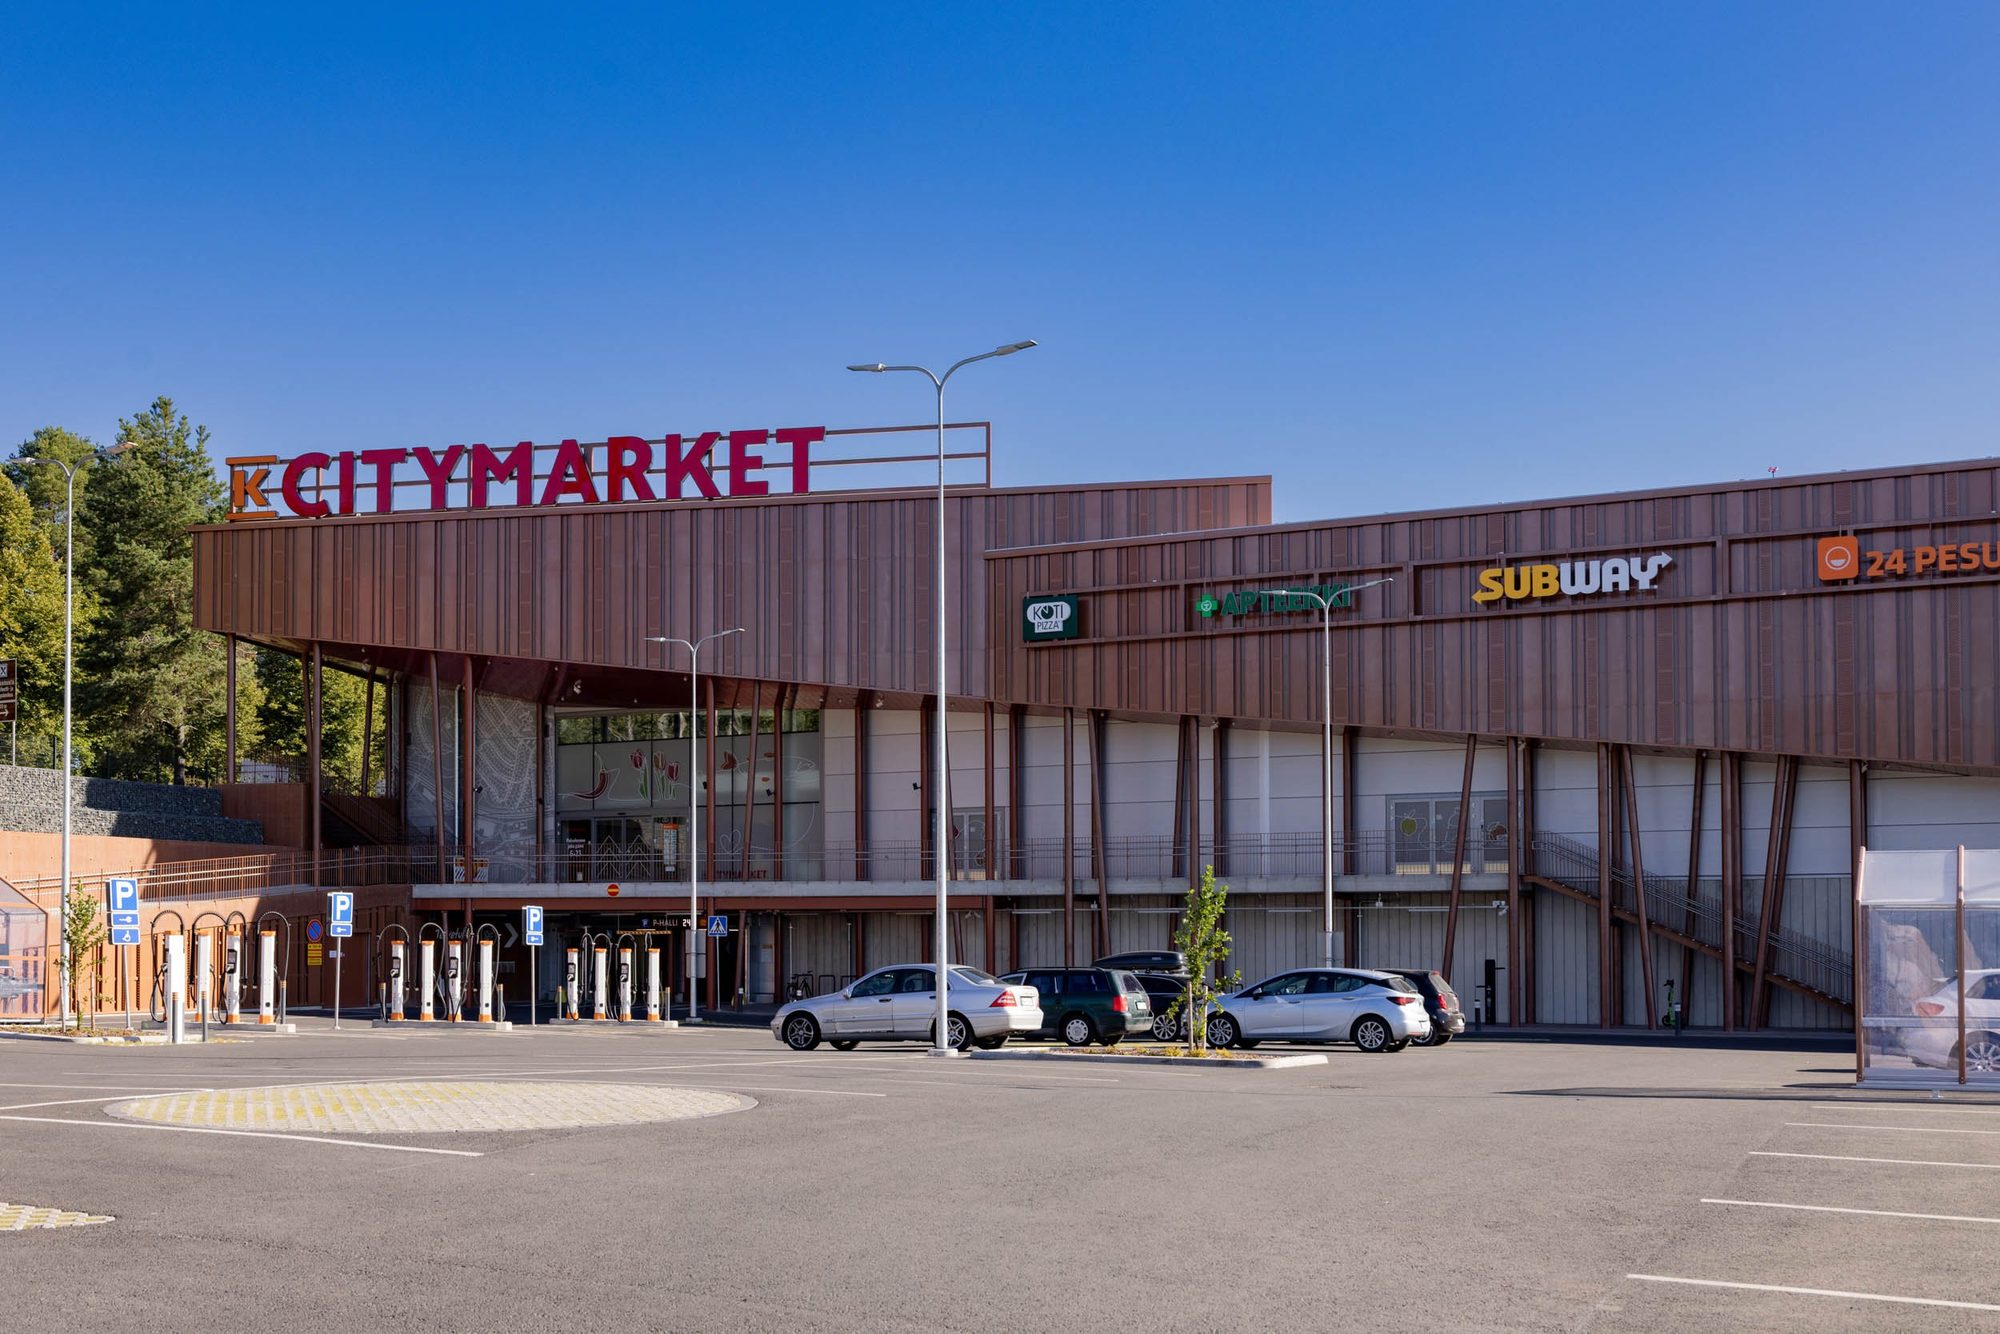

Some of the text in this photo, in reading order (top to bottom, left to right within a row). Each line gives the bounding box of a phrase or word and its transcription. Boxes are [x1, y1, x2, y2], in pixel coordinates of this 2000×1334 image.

[232, 426, 826, 519] K CITYMARKET
[1866, 549, 1907, 577] 24
[1471, 552, 1672, 605] SUBWAY
[1033, 604, 1063, 620] KOTI
[1221, 583, 1350, 616] APTEEKKI
[1037, 621, 1060, 631] PIZZA
[116, 881, 133, 909] P
[336, 895, 350, 920] P
[530, 908, 541, 931] P
